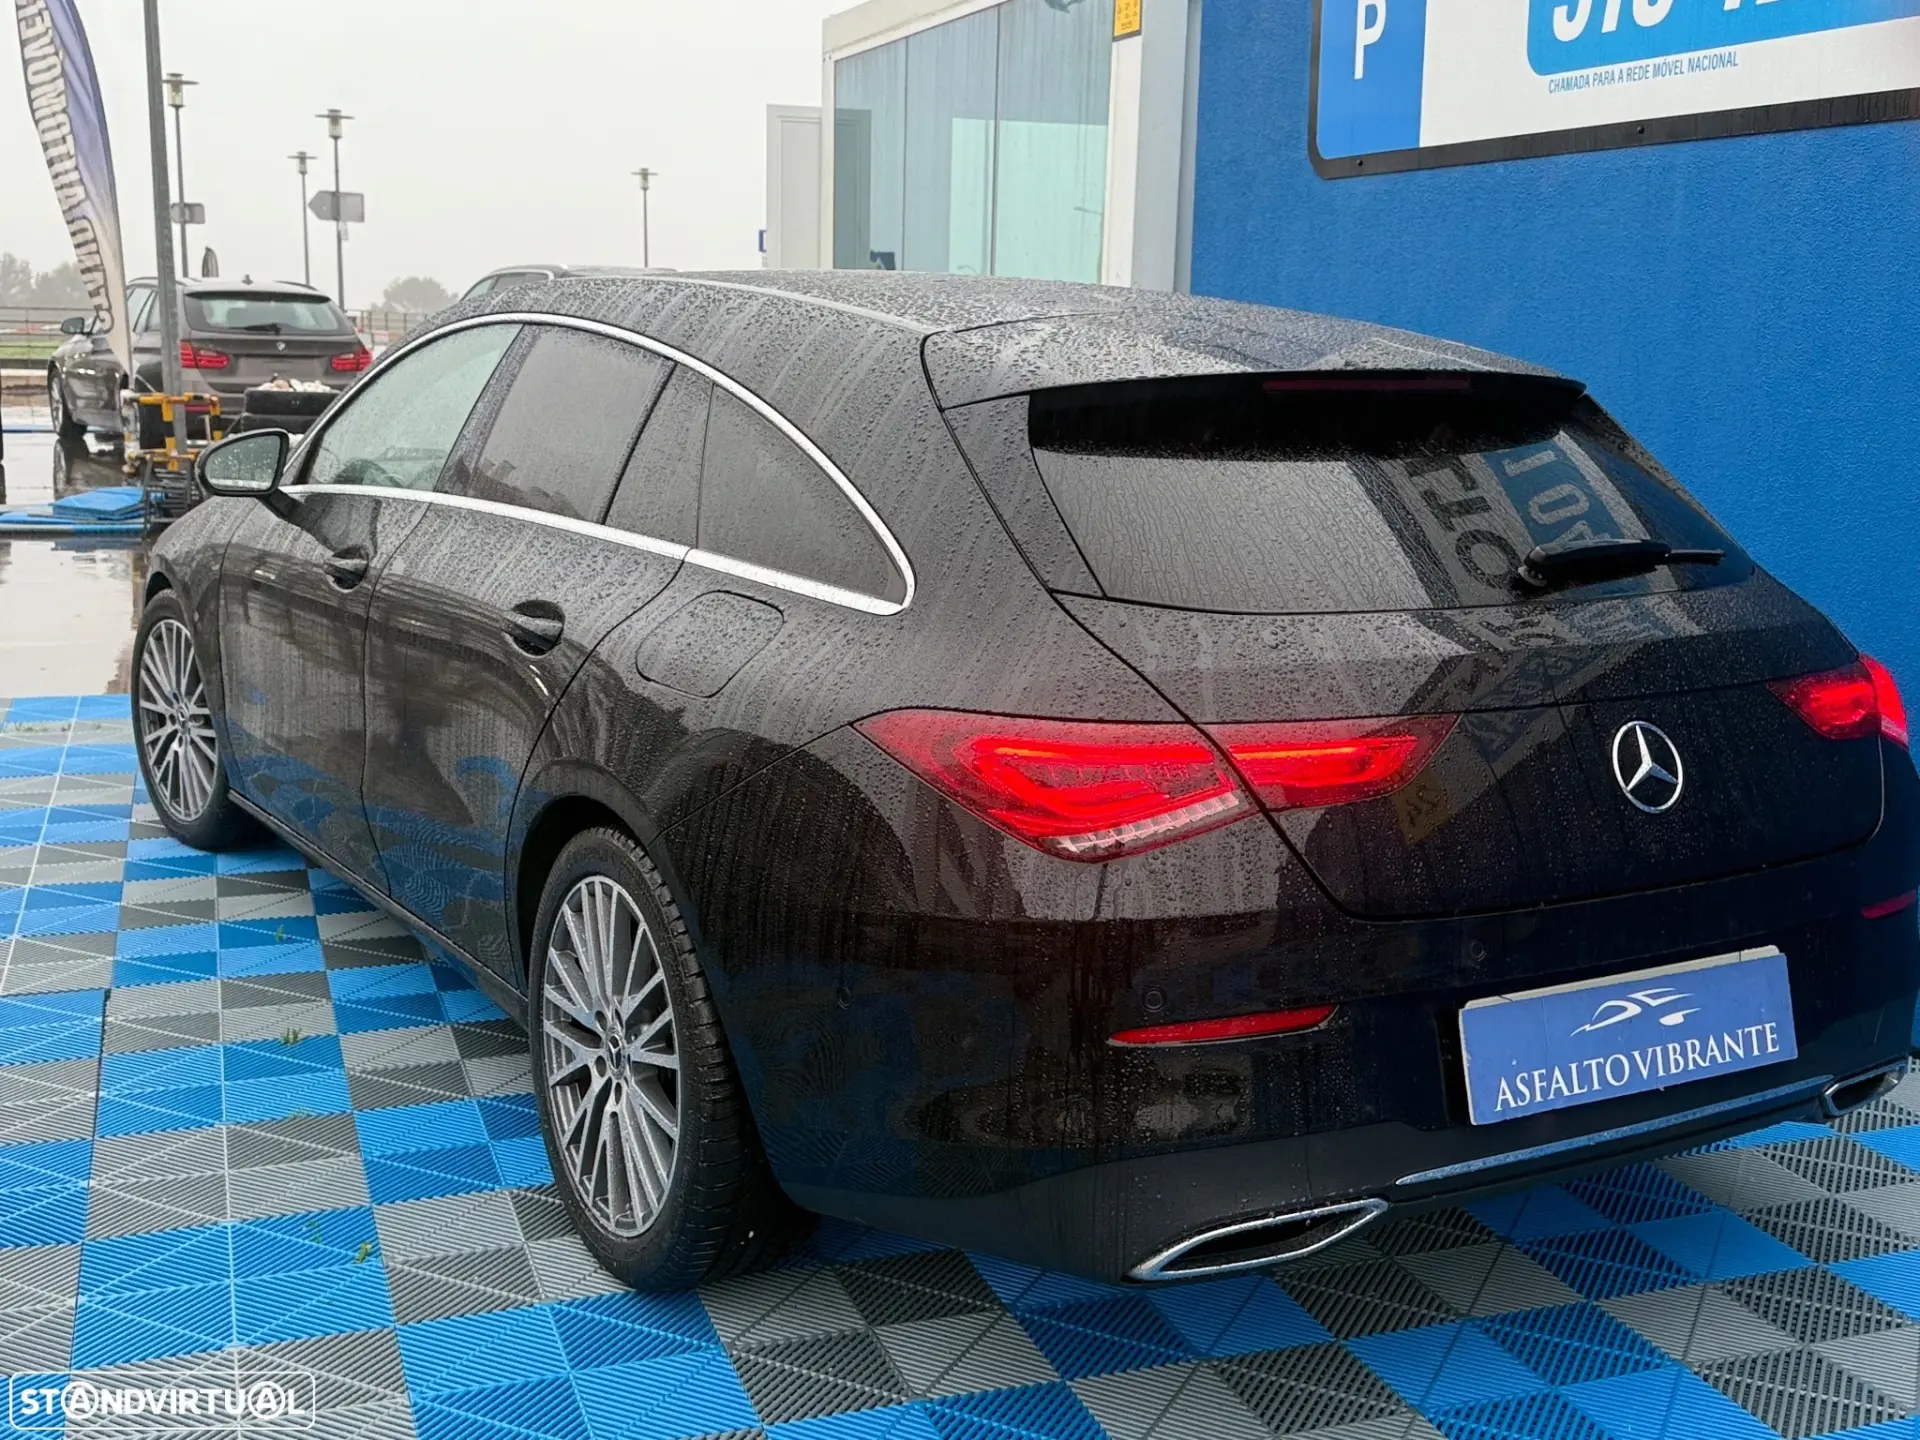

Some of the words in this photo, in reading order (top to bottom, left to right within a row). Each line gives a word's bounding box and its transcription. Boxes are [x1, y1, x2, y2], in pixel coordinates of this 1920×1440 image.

[1548, 75, 1590, 94] CHAMADA
[1592, 71, 1616, 88] PARA
[1617, 69, 1624, 84] A
[1626, 65, 1650, 83] REDE
[1652, 58, 1685, 79] MÓVEL
[1687, 51, 1739, 74] NACIONAL
[1494, 1021, 1780, 1112] ASFALTOVIBRANTE
